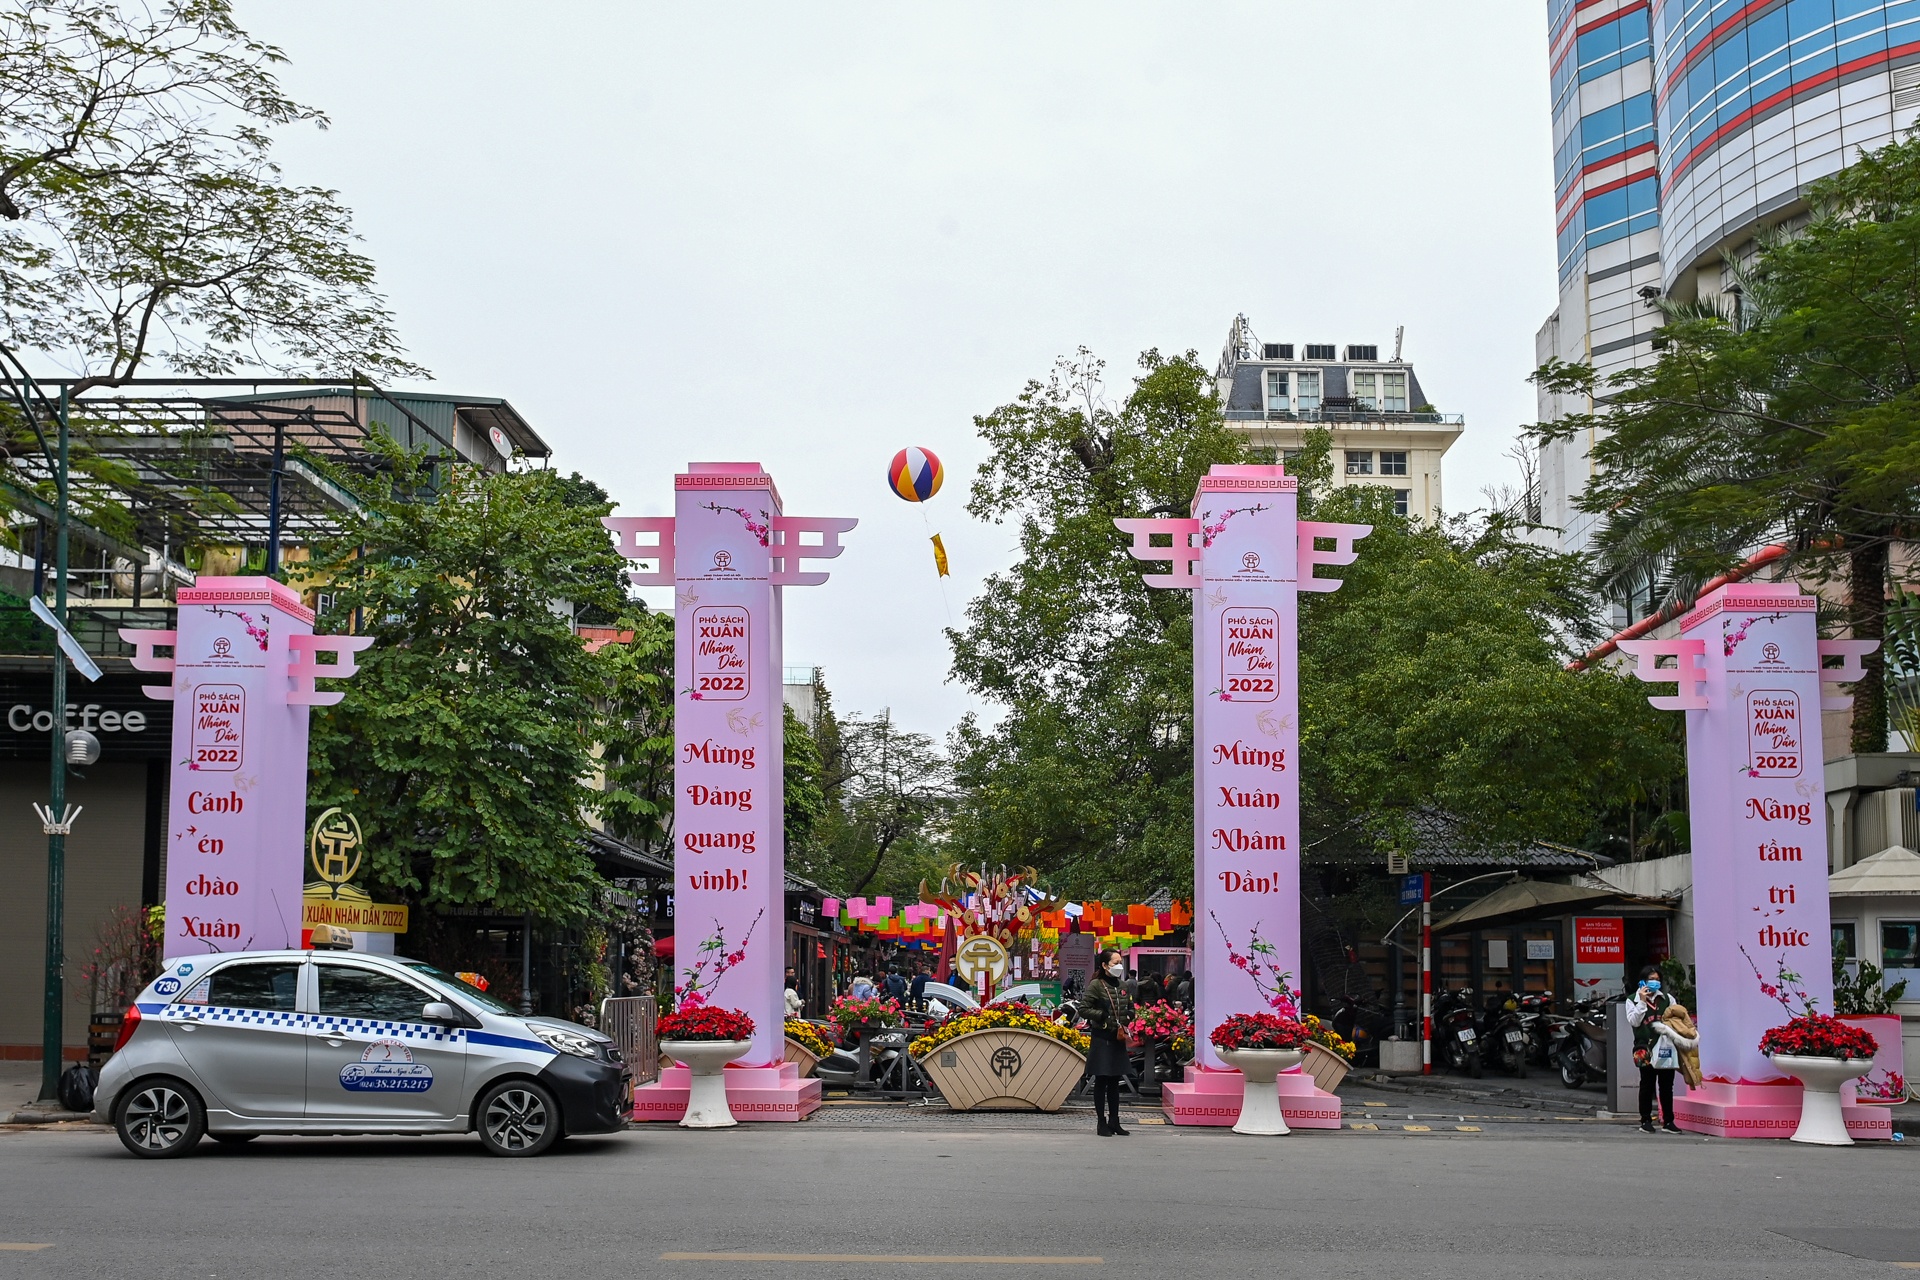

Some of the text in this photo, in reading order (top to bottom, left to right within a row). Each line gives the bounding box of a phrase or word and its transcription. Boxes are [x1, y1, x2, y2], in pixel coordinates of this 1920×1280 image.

[699, 614, 744, 623] PHỐ SÁCH
[1228, 616, 1273, 625] PHỐ SÁCH
[699, 624, 744, 637] XUÂN
[1228, 625, 1273, 639] XUÂN
[699, 640, 735, 656] Nhâm
[1228, 641, 1265, 657] Nhâm
[718, 654, 745, 670] Dần
[1247, 656, 1274, 671] Dần
[699, 677, 745, 691] 2022
[1228, 678, 1274, 692] 2022
[199, 692, 240, 701] PHỐ SÁCH
[1753, 697, 1770, 706] PHỐ
[199, 700, 240, 713] XUÂN
[1754, 706, 1795, 719] XUÂN
[198, 715, 232, 730] Nhâm
[1754, 721, 1788, 736] Nhâm
[214, 728, 239, 743] Dần
[1772, 734, 1797, 749] Dần
[197, 749, 238, 762] 2022
[682, 738, 755, 769] Mừng
[1212, 740, 1285, 772] Mừng
[1756, 756, 1797, 769] 2022
[188, 791, 243, 814] Cánh
[686, 785, 752, 811] Đảng
[1217, 786, 1280, 809] Xuân
[1745, 798, 1811, 825] Nâng
[198, 834, 224, 855] én
[684, 831, 756, 854] quang
[1211, 829, 1286, 852] Nhâm
[1758, 839, 1803, 862] tầm
[186, 874, 239, 897] chào
[689, 868, 748, 892] vinh!
[1218, 869, 1279, 894] Dần!
[1768, 884, 1795, 904] tri
[306, 903, 404, 927] XUÂN NHÂM DẦN 2022
[179, 916, 241, 940] Xuân
[1596, 935, 1611, 943] CÁCH
[1758, 924, 1810, 949] thức
[1585, 944, 1593, 953] TẾ
[1594, 946, 1606, 954] TẠM
[1607, 945, 1620, 953] THỜI
[158, 981, 179, 992] 739
[390, 1040, 405, 1050] TAXI
